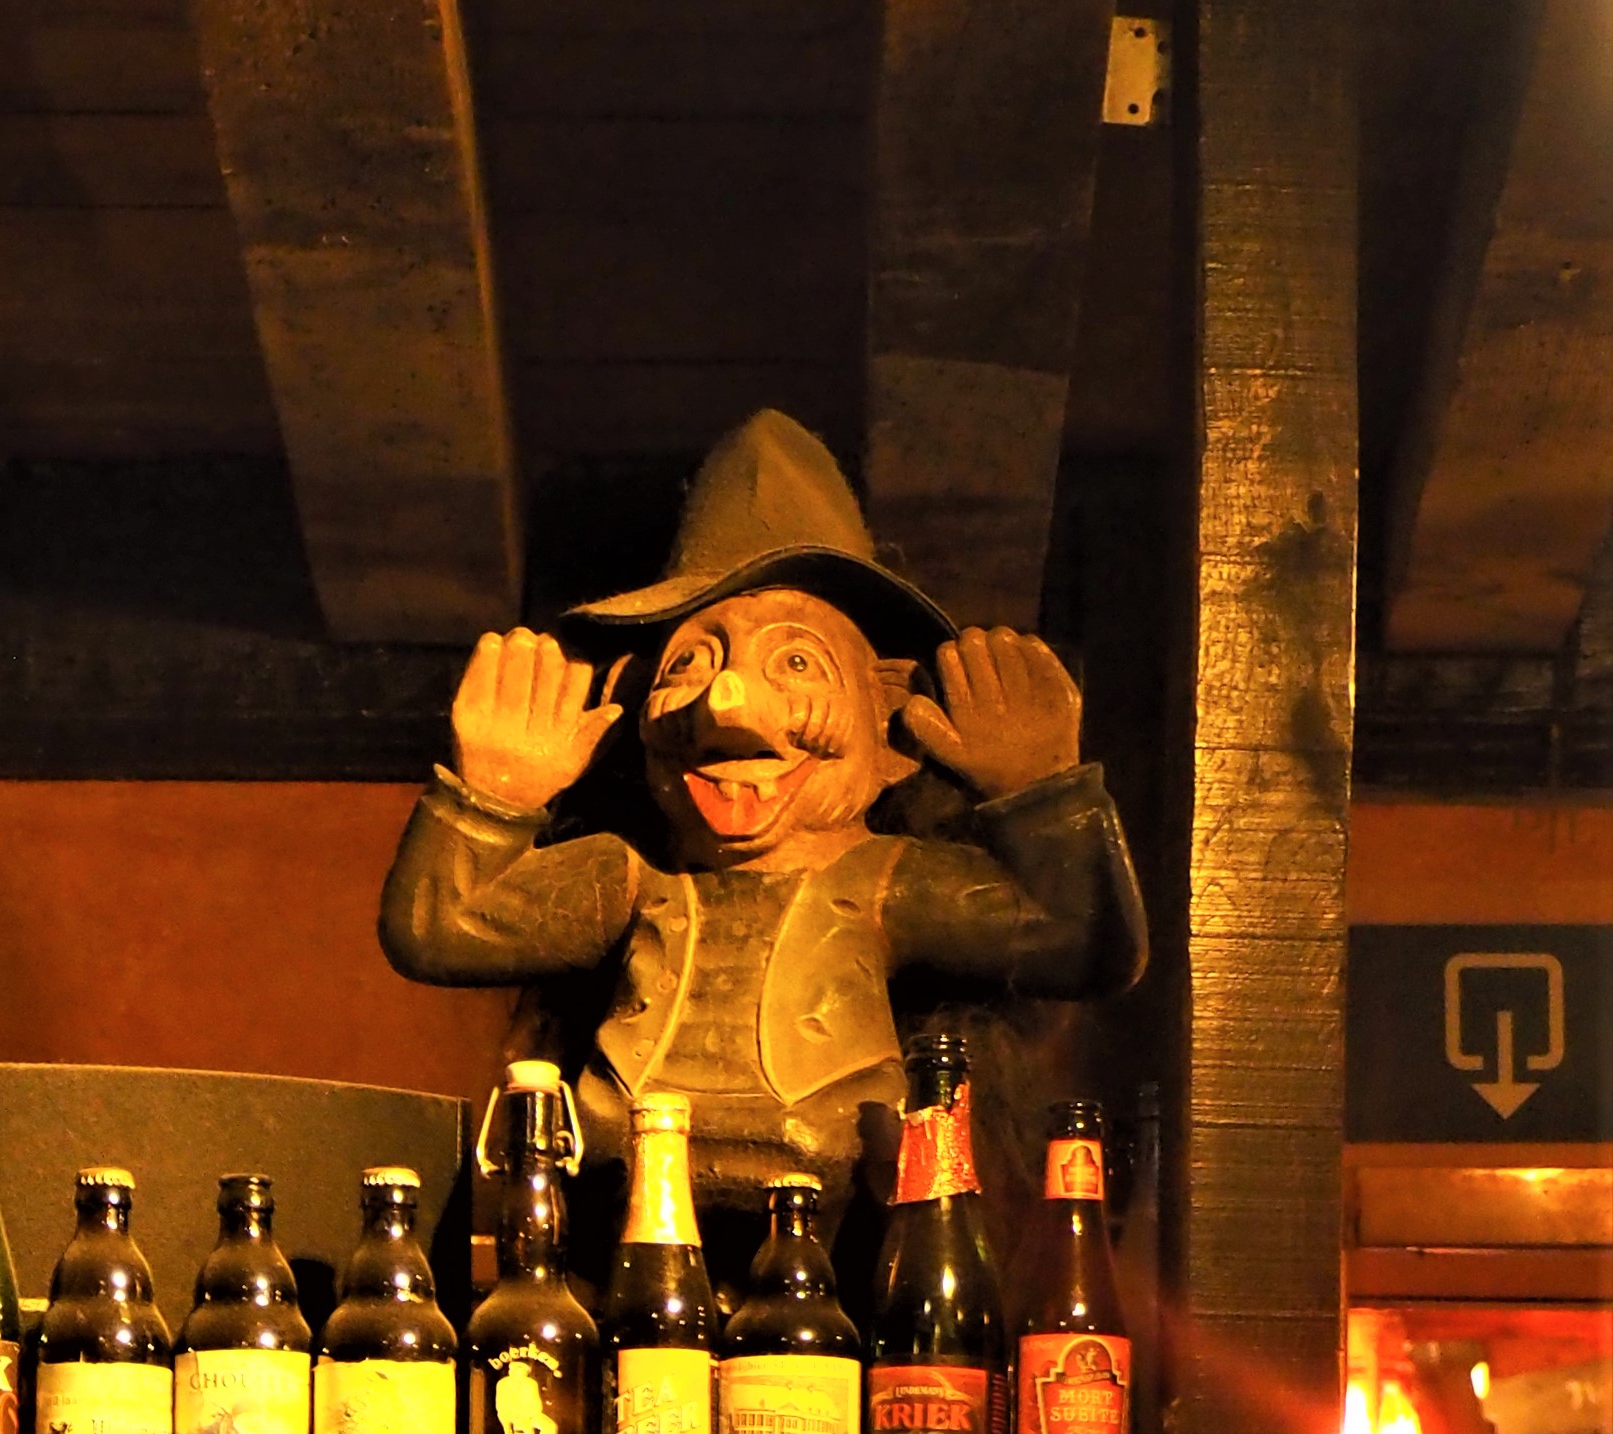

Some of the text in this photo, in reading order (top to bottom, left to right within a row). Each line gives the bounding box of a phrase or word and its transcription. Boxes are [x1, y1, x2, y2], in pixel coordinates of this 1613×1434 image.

[1059, 1389, 1113, 1406] MORT
[873, 1402, 972, 1431] KRIEK
[1050, 1406, 1120, 1424] SUBITE
